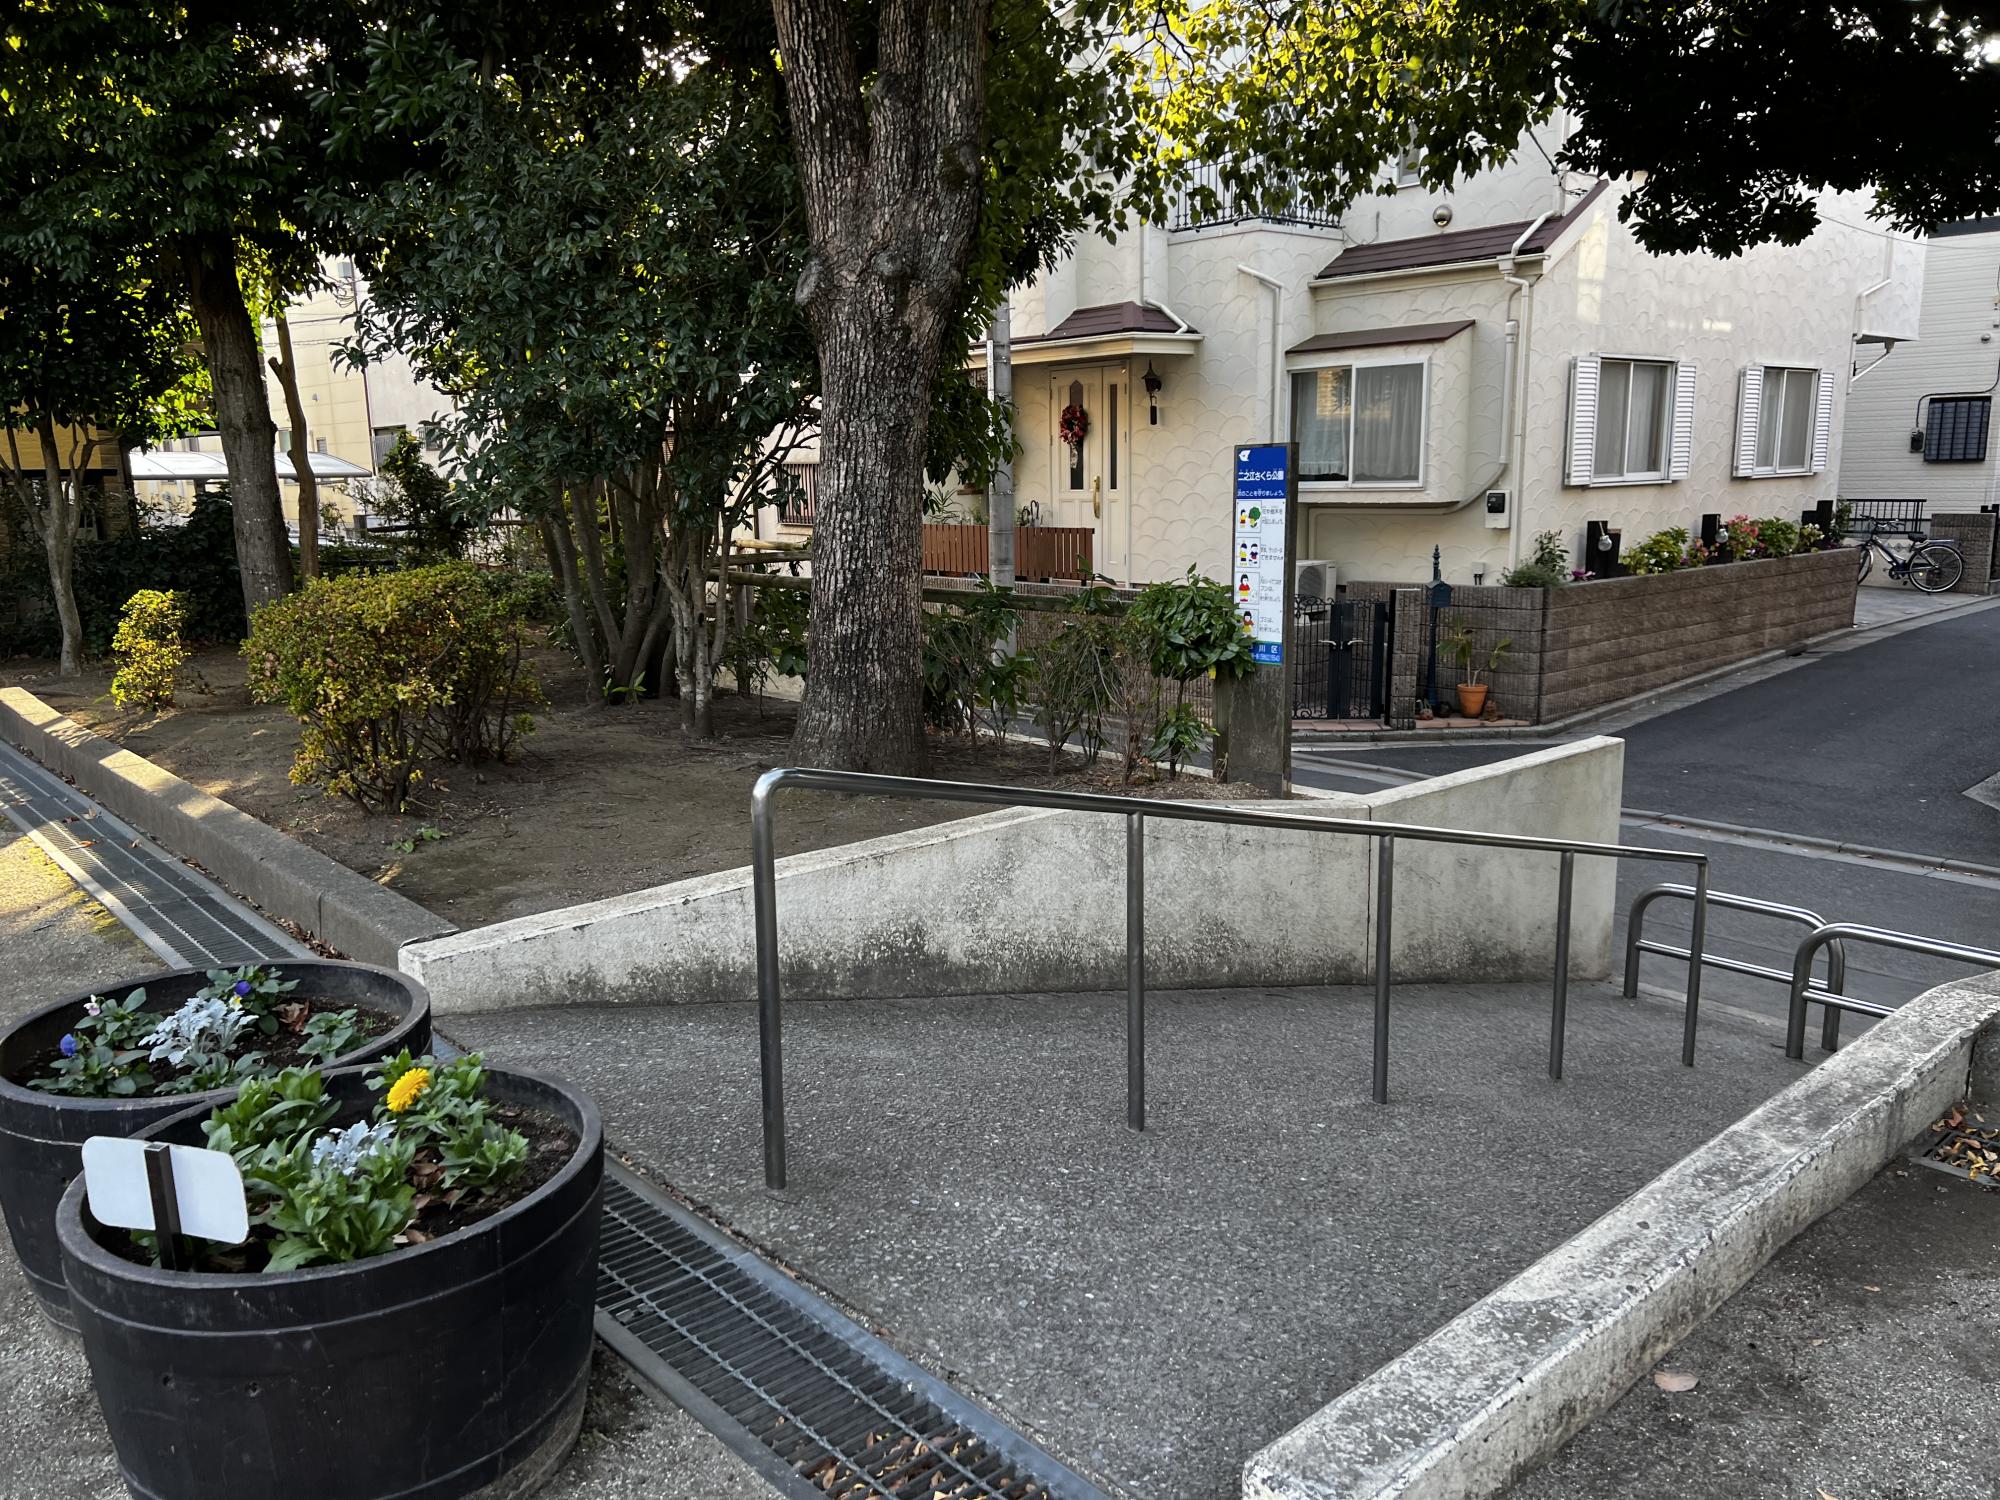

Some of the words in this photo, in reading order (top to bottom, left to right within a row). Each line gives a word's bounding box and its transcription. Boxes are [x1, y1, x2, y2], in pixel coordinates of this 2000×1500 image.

[1238, 470, 1284, 481] 二之江さくら公園
